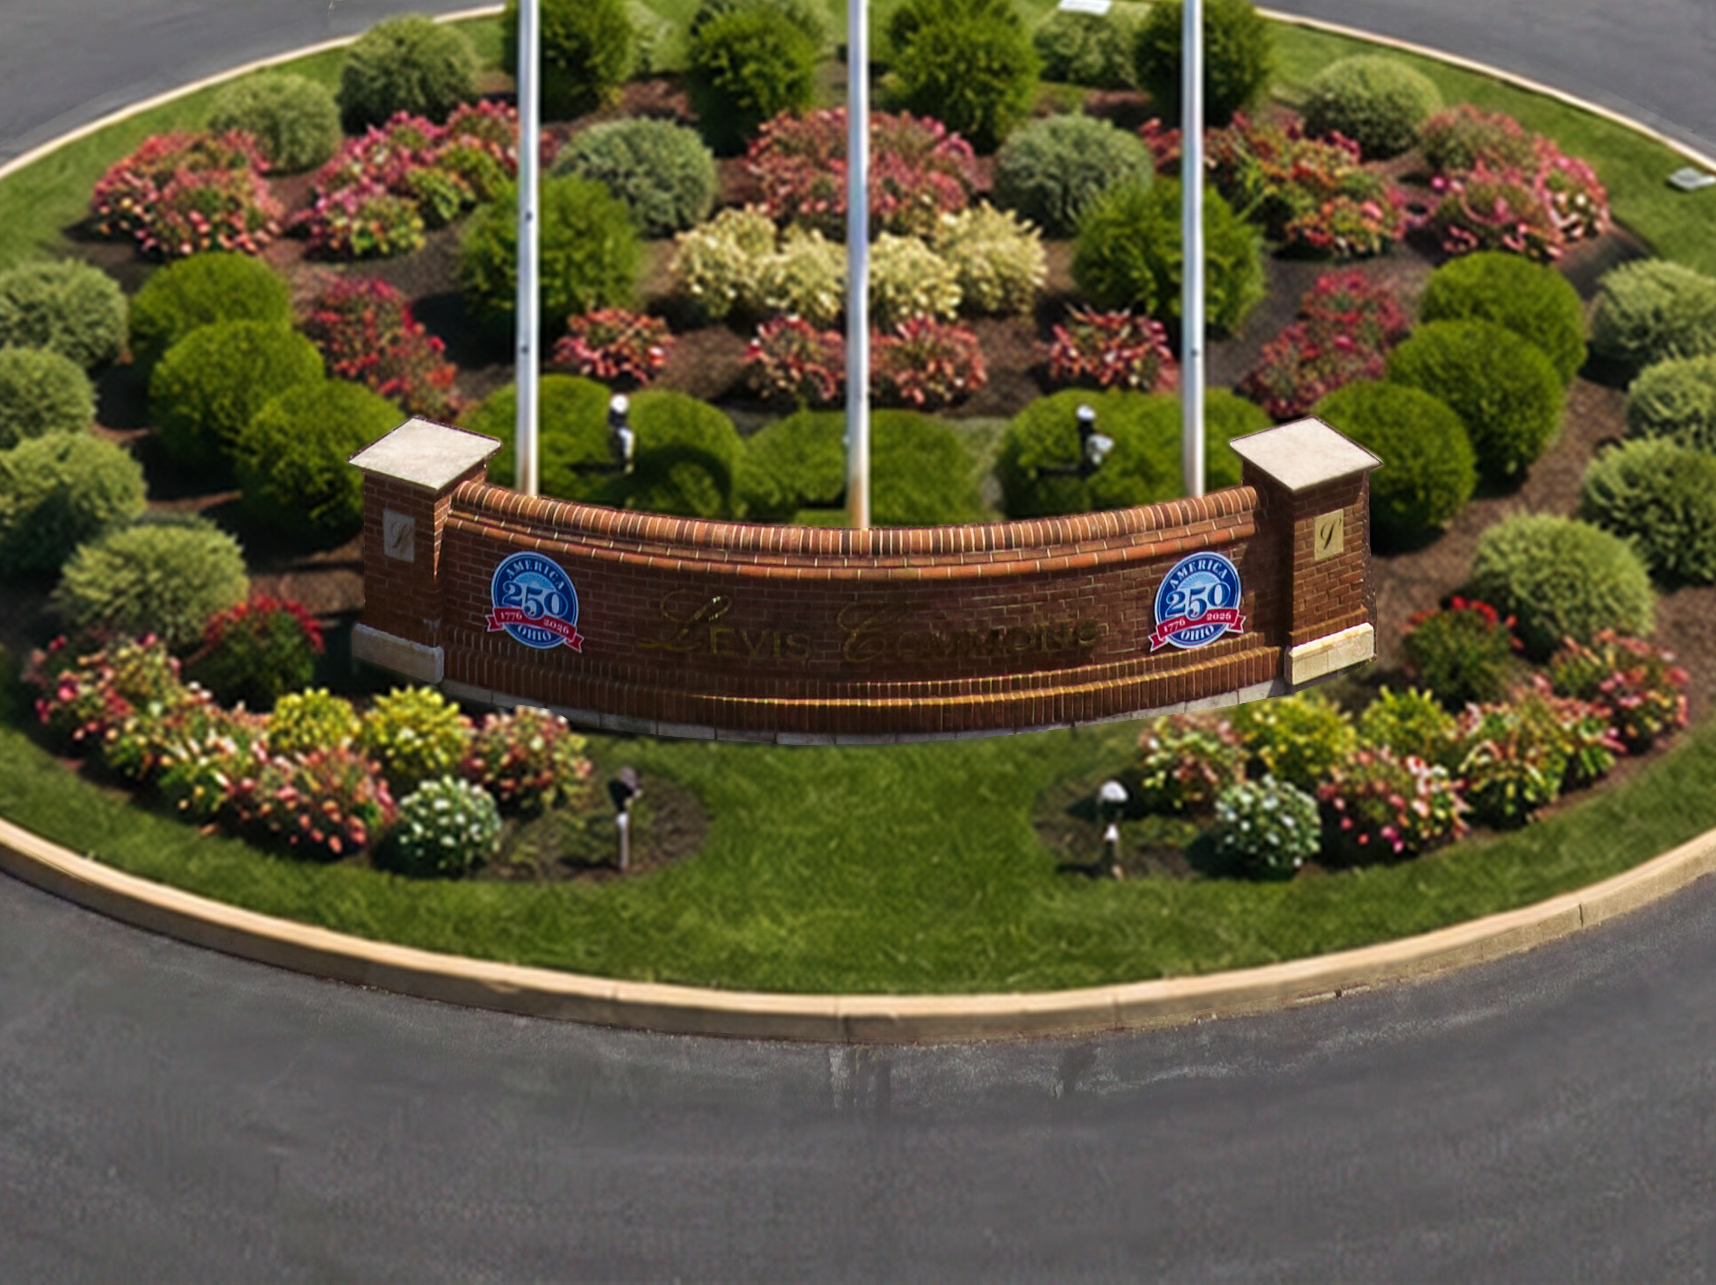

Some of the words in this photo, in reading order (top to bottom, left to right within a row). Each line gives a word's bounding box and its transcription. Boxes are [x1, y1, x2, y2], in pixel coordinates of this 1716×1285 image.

[505, 559, 564, 591] AMERICA
[1170, 559, 1228, 589] AMERICA
[502, 581, 569, 621] 250
[1165, 581, 1231, 621] 250
[500, 610, 523, 622] 1776
[542, 617, 570, 636] 2026
[517, 624, 552, 642] OHIO
[1163, 618, 1186, 633] 1776
[1206, 611, 1232, 622] 2026
[1180, 624, 1215, 642] OHIO
